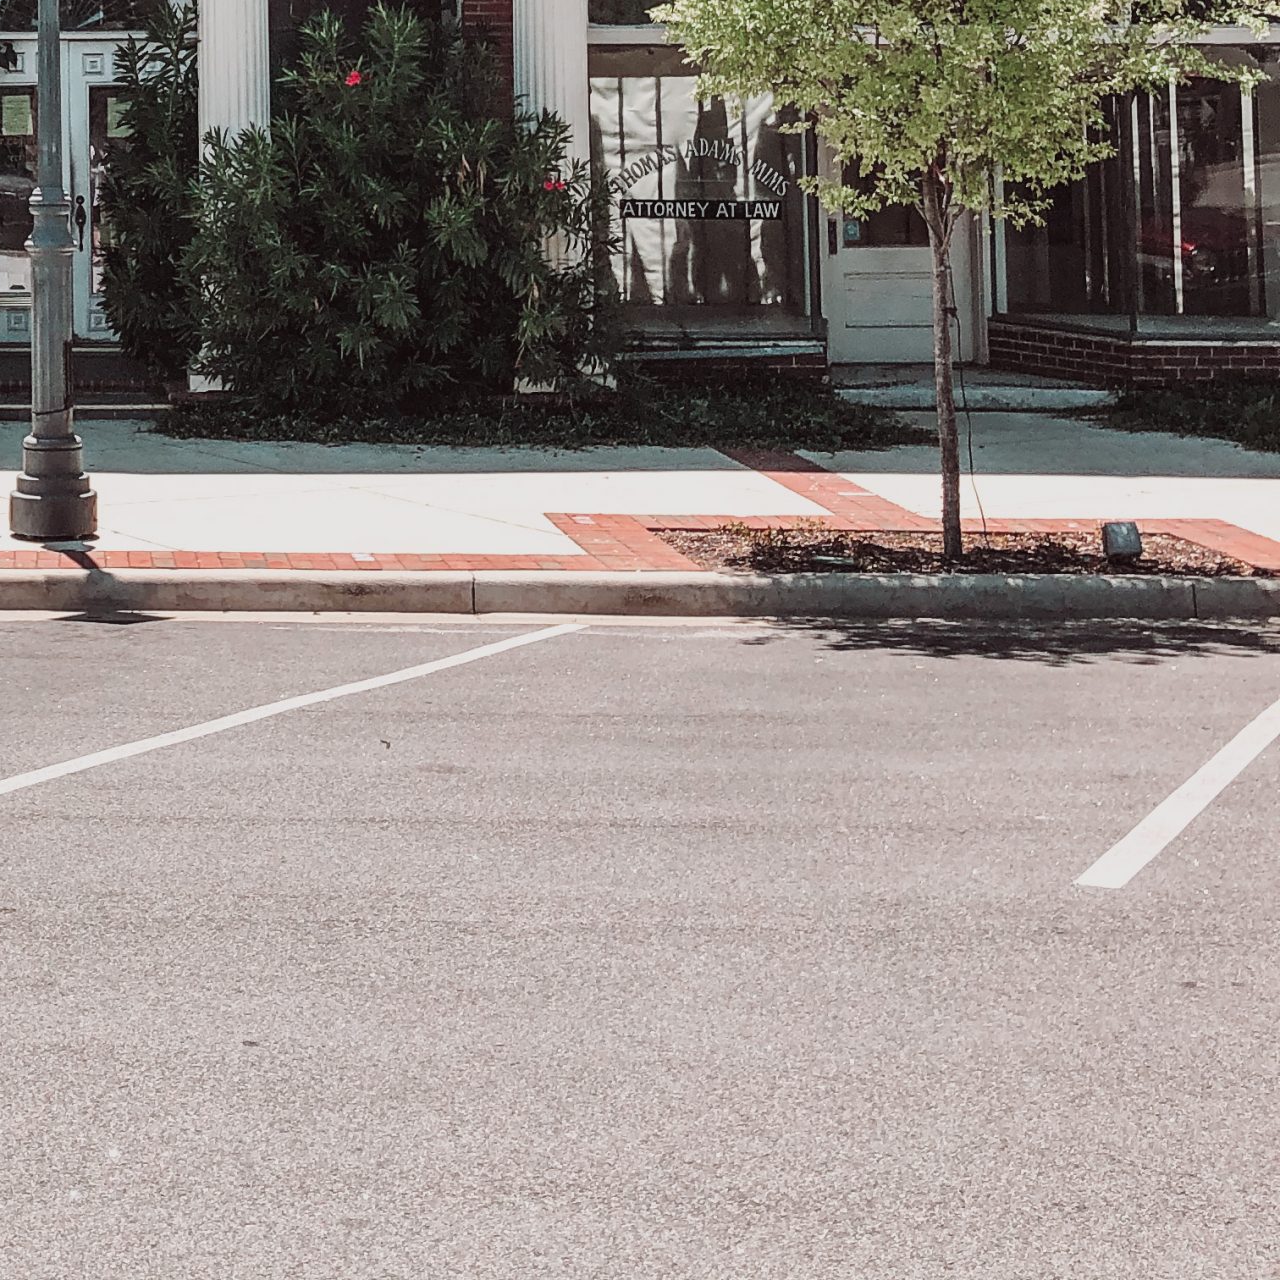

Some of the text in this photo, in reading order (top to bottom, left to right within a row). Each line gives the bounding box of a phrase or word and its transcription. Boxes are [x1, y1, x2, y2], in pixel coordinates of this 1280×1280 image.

[751, 158, 790, 197] MIMS
[622, 202, 780, 218] ATTORNEY AT LAW
